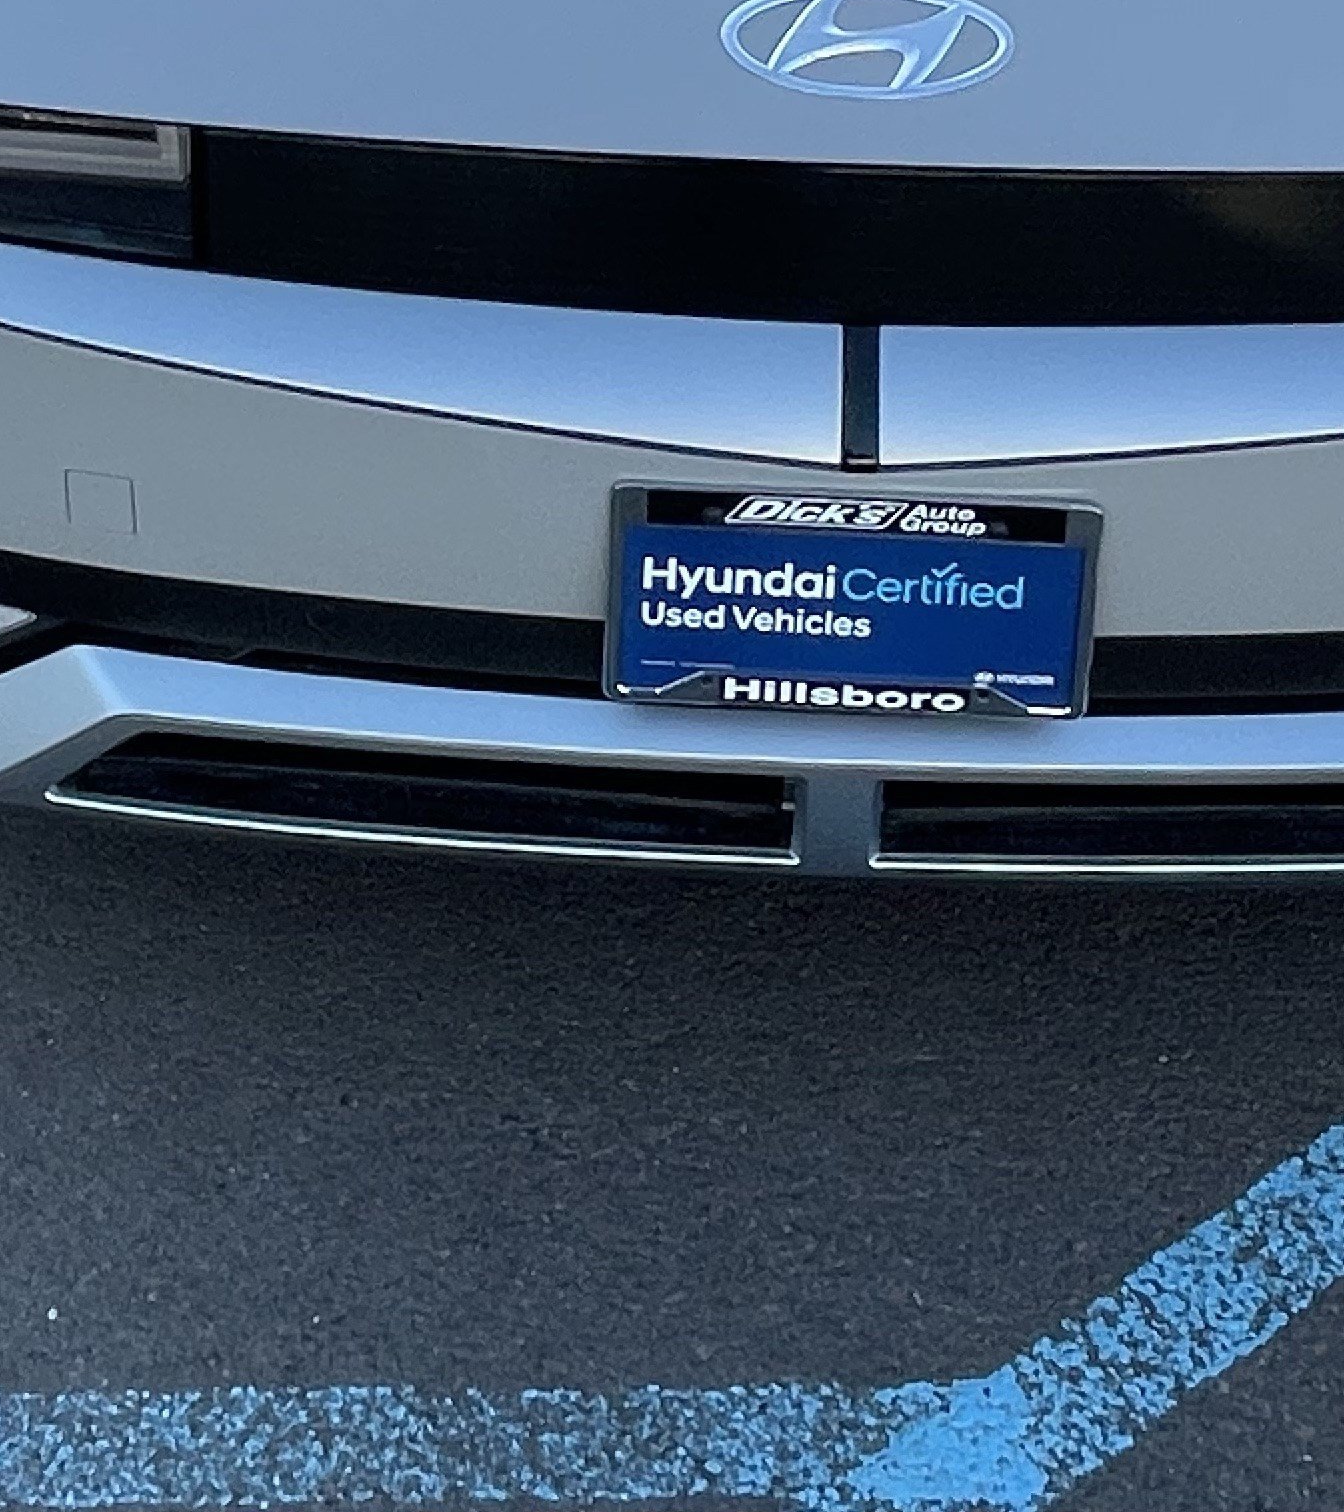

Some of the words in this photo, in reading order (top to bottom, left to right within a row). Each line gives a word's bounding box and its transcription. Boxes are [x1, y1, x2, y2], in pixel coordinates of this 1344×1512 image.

[900, 517, 987, 537] Group
[907, 504, 976, 521] Auto
[642, 556, 836, 599] Hyundai
[842, 562, 1025, 610] Certified
[641, 600, 726, 630] Used
[732, 604, 872, 638] Vehicles
[723, 676, 965, 712] Hillsboro
